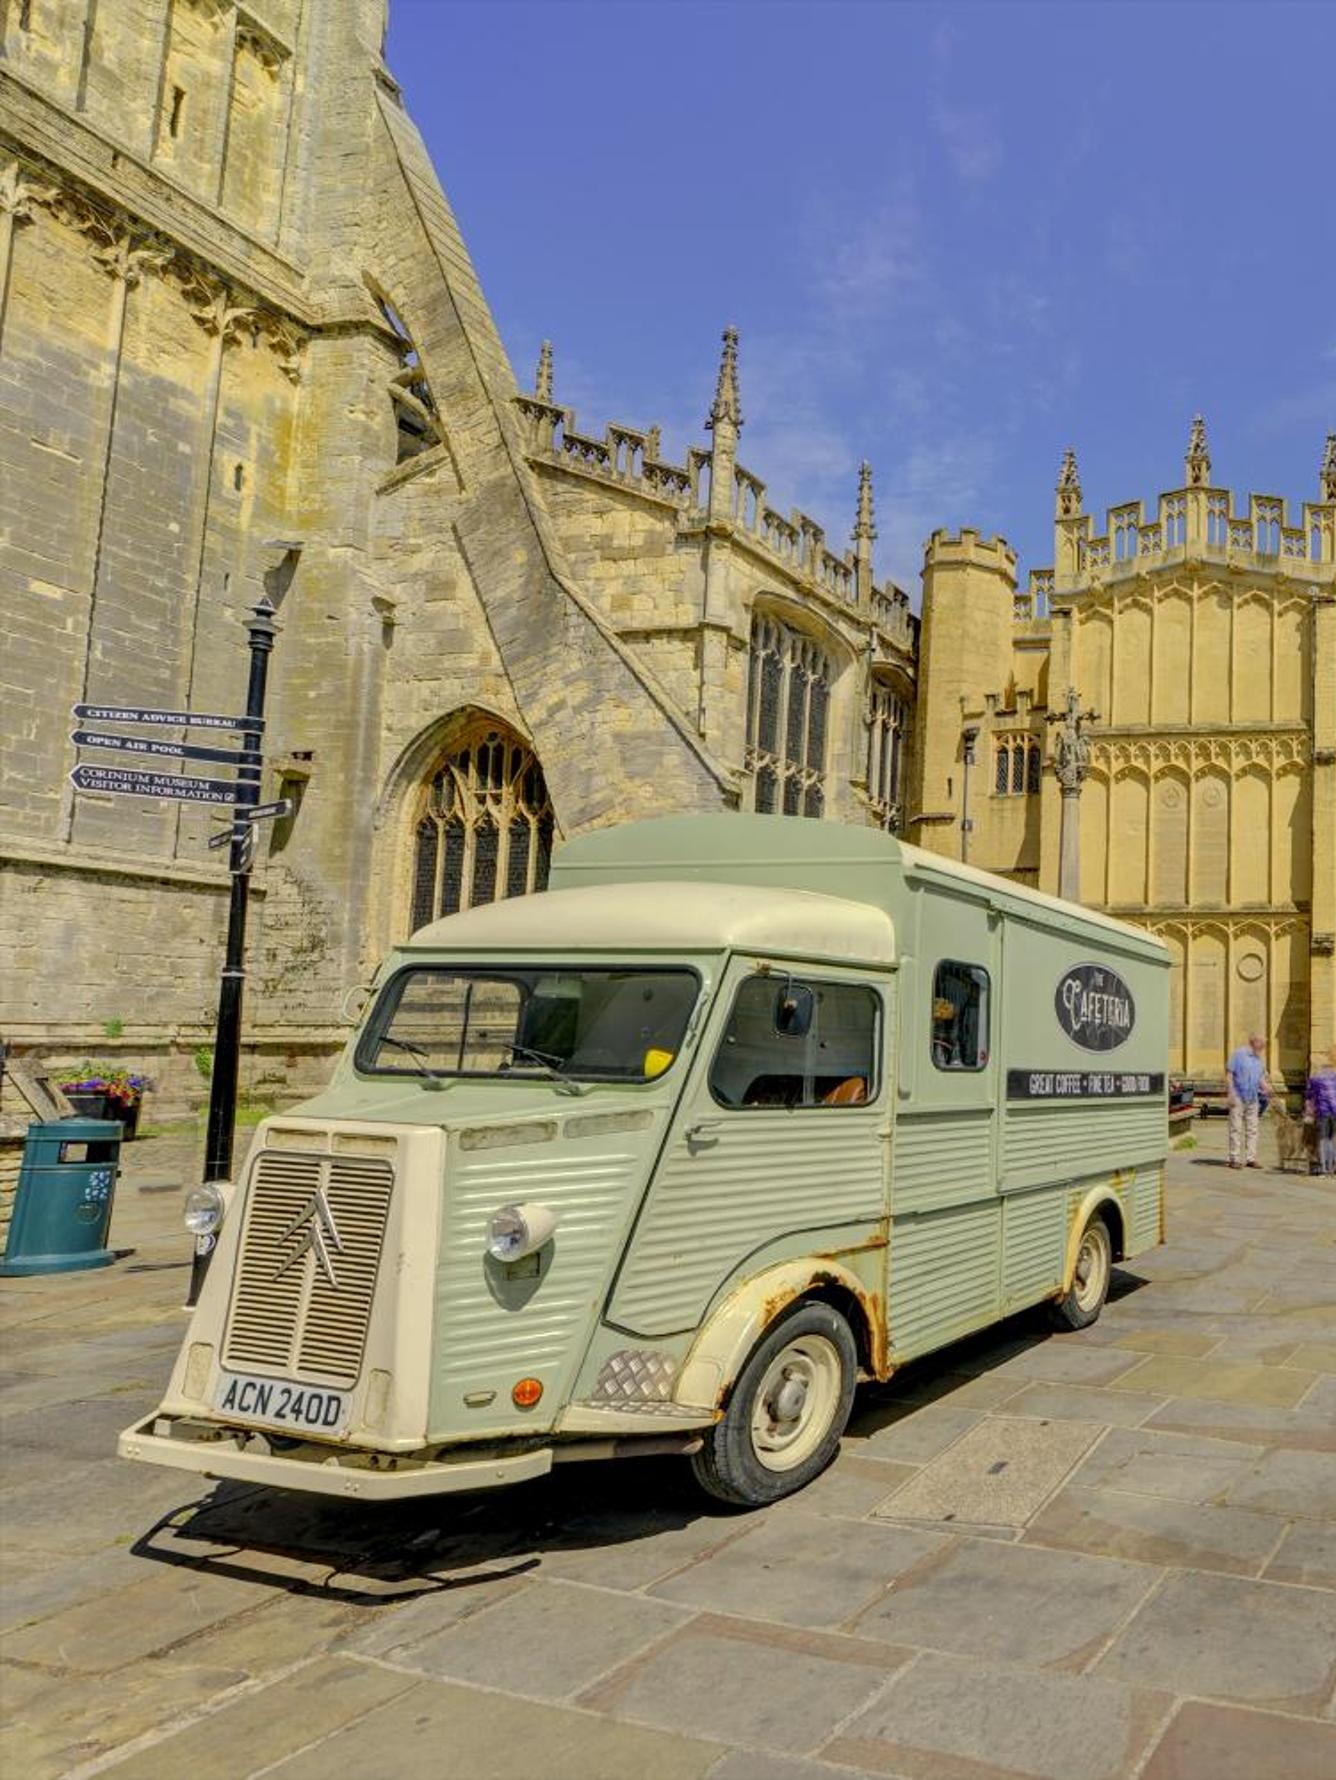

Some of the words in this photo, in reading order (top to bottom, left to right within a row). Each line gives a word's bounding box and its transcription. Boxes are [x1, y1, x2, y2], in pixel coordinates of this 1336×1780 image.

[86, 709, 139, 720] CITIZEN
[142, 712, 187, 725] ADVICE
[190, 716, 237, 728] BUREAU
[86, 735, 121, 747] OPEN
[125, 740, 149, 751] AIR
[151, 744, 185, 756] POOL
[80, 767, 149, 783] CORINIUM
[152, 776, 210, 790] MUSEUM
[80, 777, 134, 791] VISITOR
[136, 784, 222, 800] INFORMATION
[1055, 1073, 1082, 1094] COFFEE
[222, 1379, 273, 1415] ACN
[273, 1387, 341, 1427] 240D
